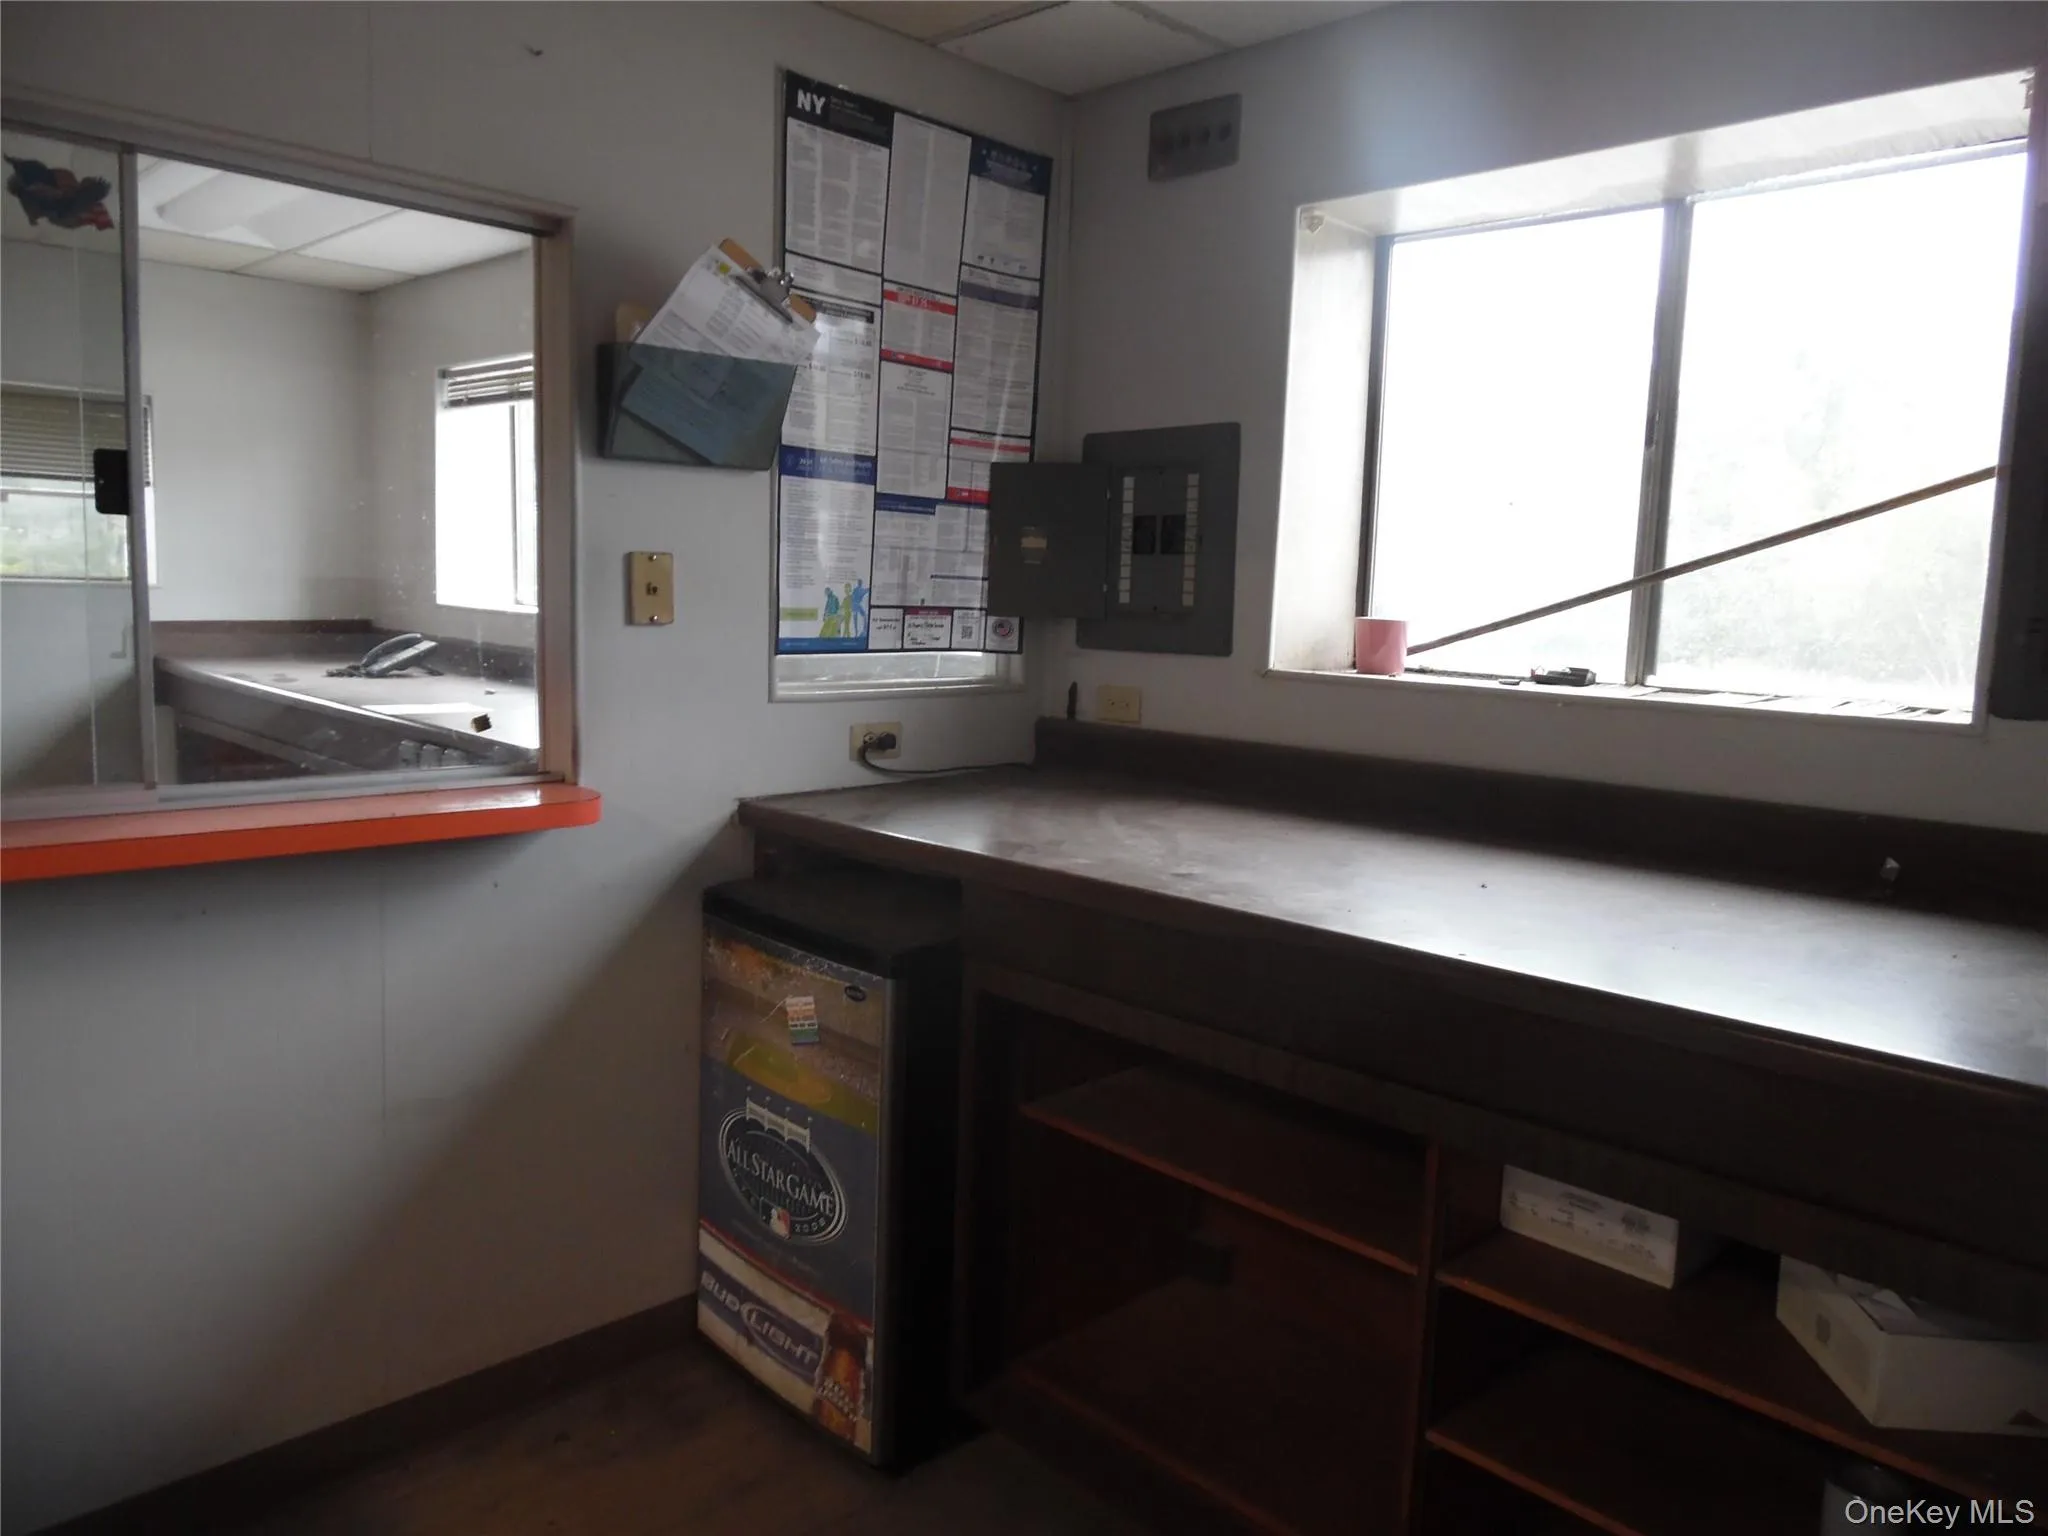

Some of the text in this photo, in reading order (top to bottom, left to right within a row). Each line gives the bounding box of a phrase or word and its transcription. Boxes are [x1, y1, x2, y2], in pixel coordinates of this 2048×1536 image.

[796, 88, 826, 115] NY
[786, 1174, 835, 1217] GAME
[700, 1270, 820, 1365] BUD LIGHT
